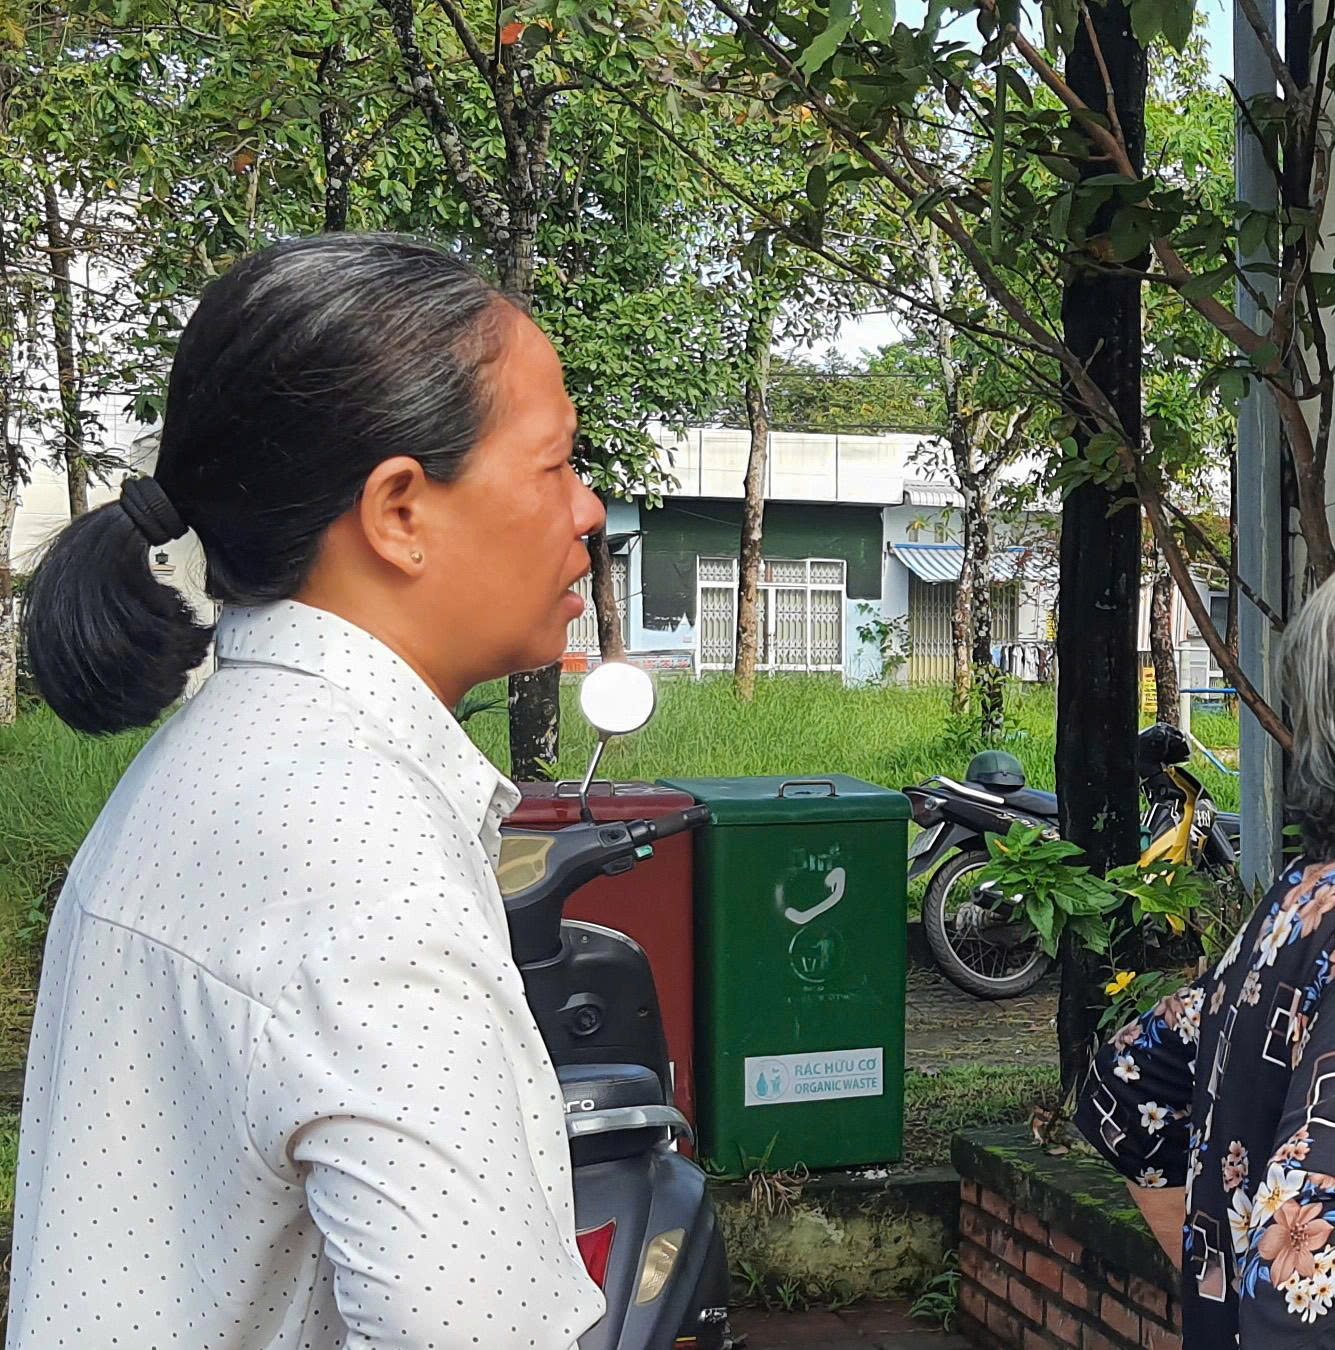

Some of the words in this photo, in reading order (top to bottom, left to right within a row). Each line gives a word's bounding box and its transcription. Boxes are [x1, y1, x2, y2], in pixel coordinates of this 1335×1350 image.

[795, 1061, 822, 1077] RÁC
[825, 1058, 854, 1074] HỮU
[858, 1056, 877, 1071] CƠ
[795, 1079, 841, 1094] ORGANIC
[844, 1077, 878, 1091] WASTE
